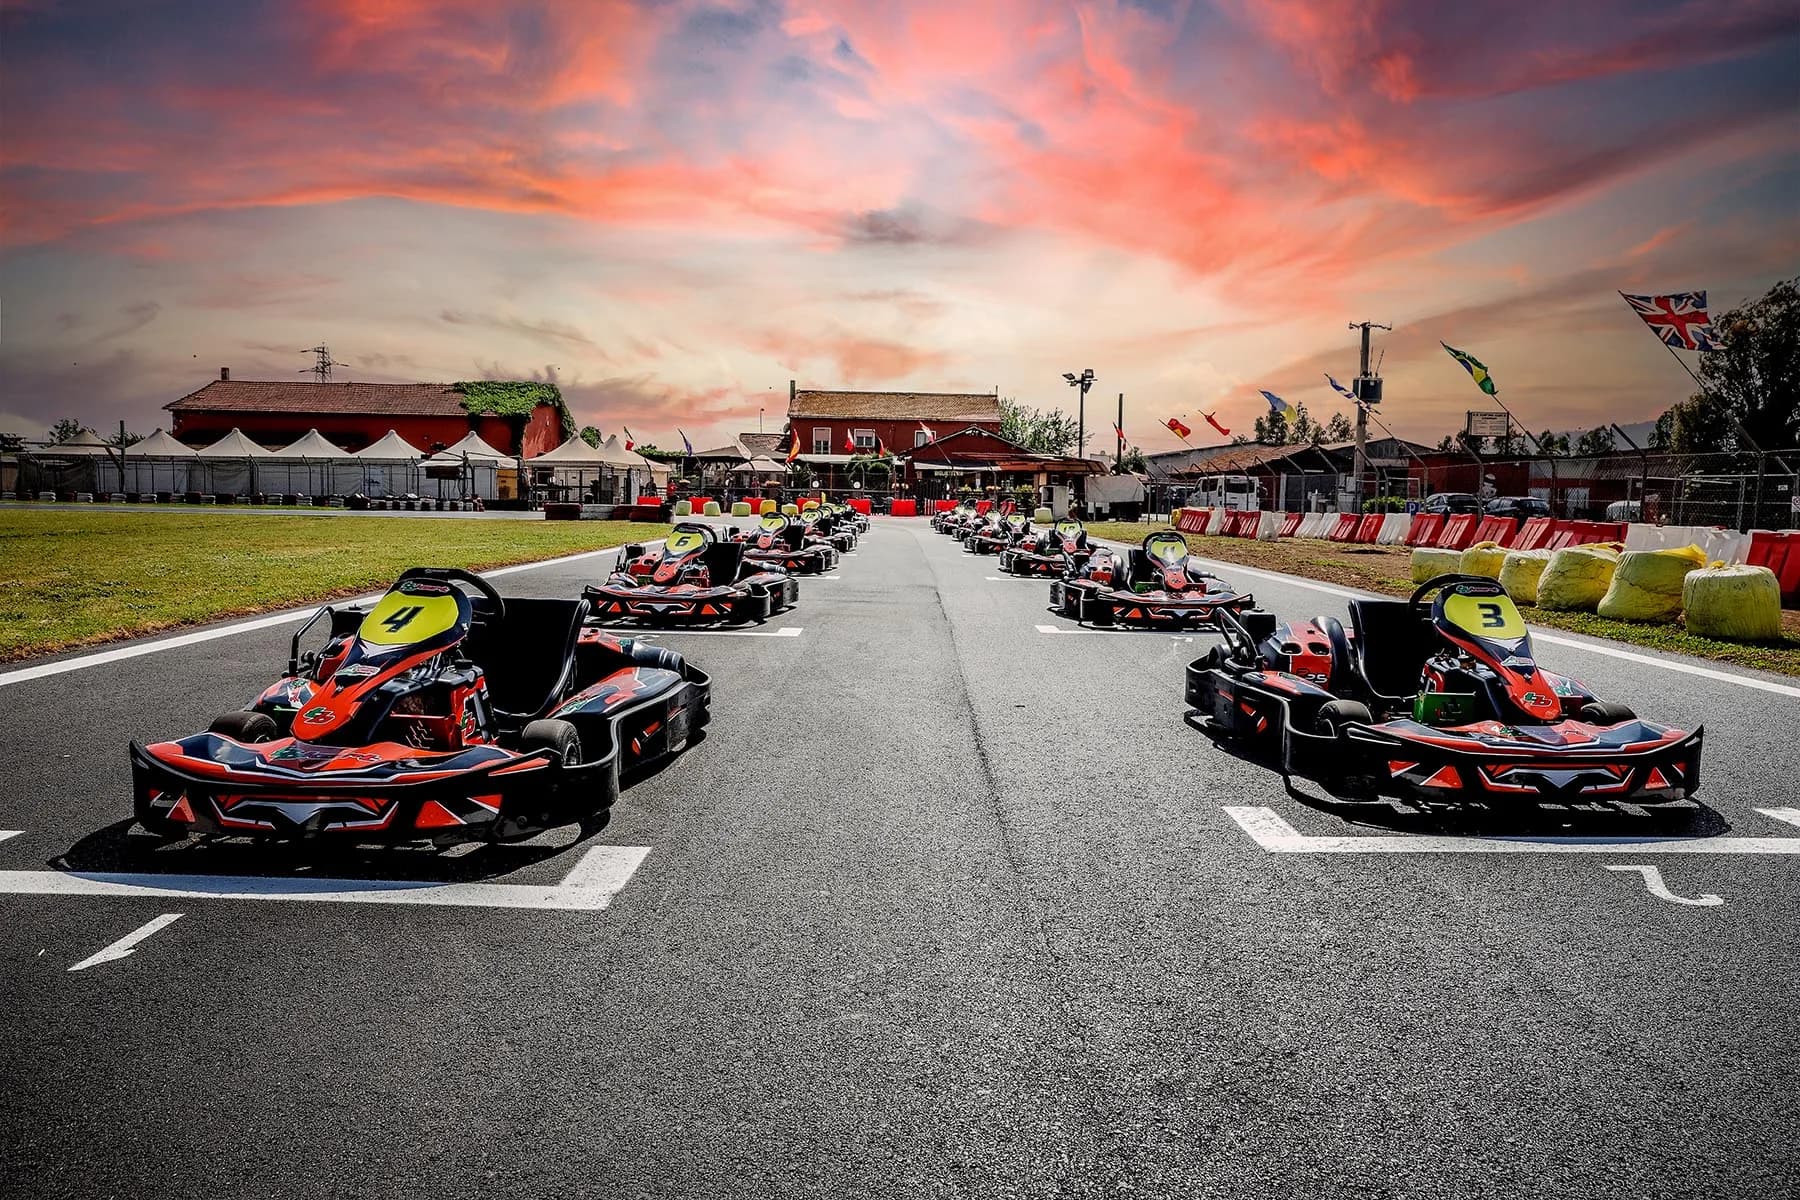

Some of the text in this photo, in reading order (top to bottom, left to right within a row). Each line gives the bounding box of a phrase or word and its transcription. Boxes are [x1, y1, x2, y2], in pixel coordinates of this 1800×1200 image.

[675, 537, 692, 547] 6
[380, 606, 425, 633] 4
[1477, 603, 1506, 628] 3
